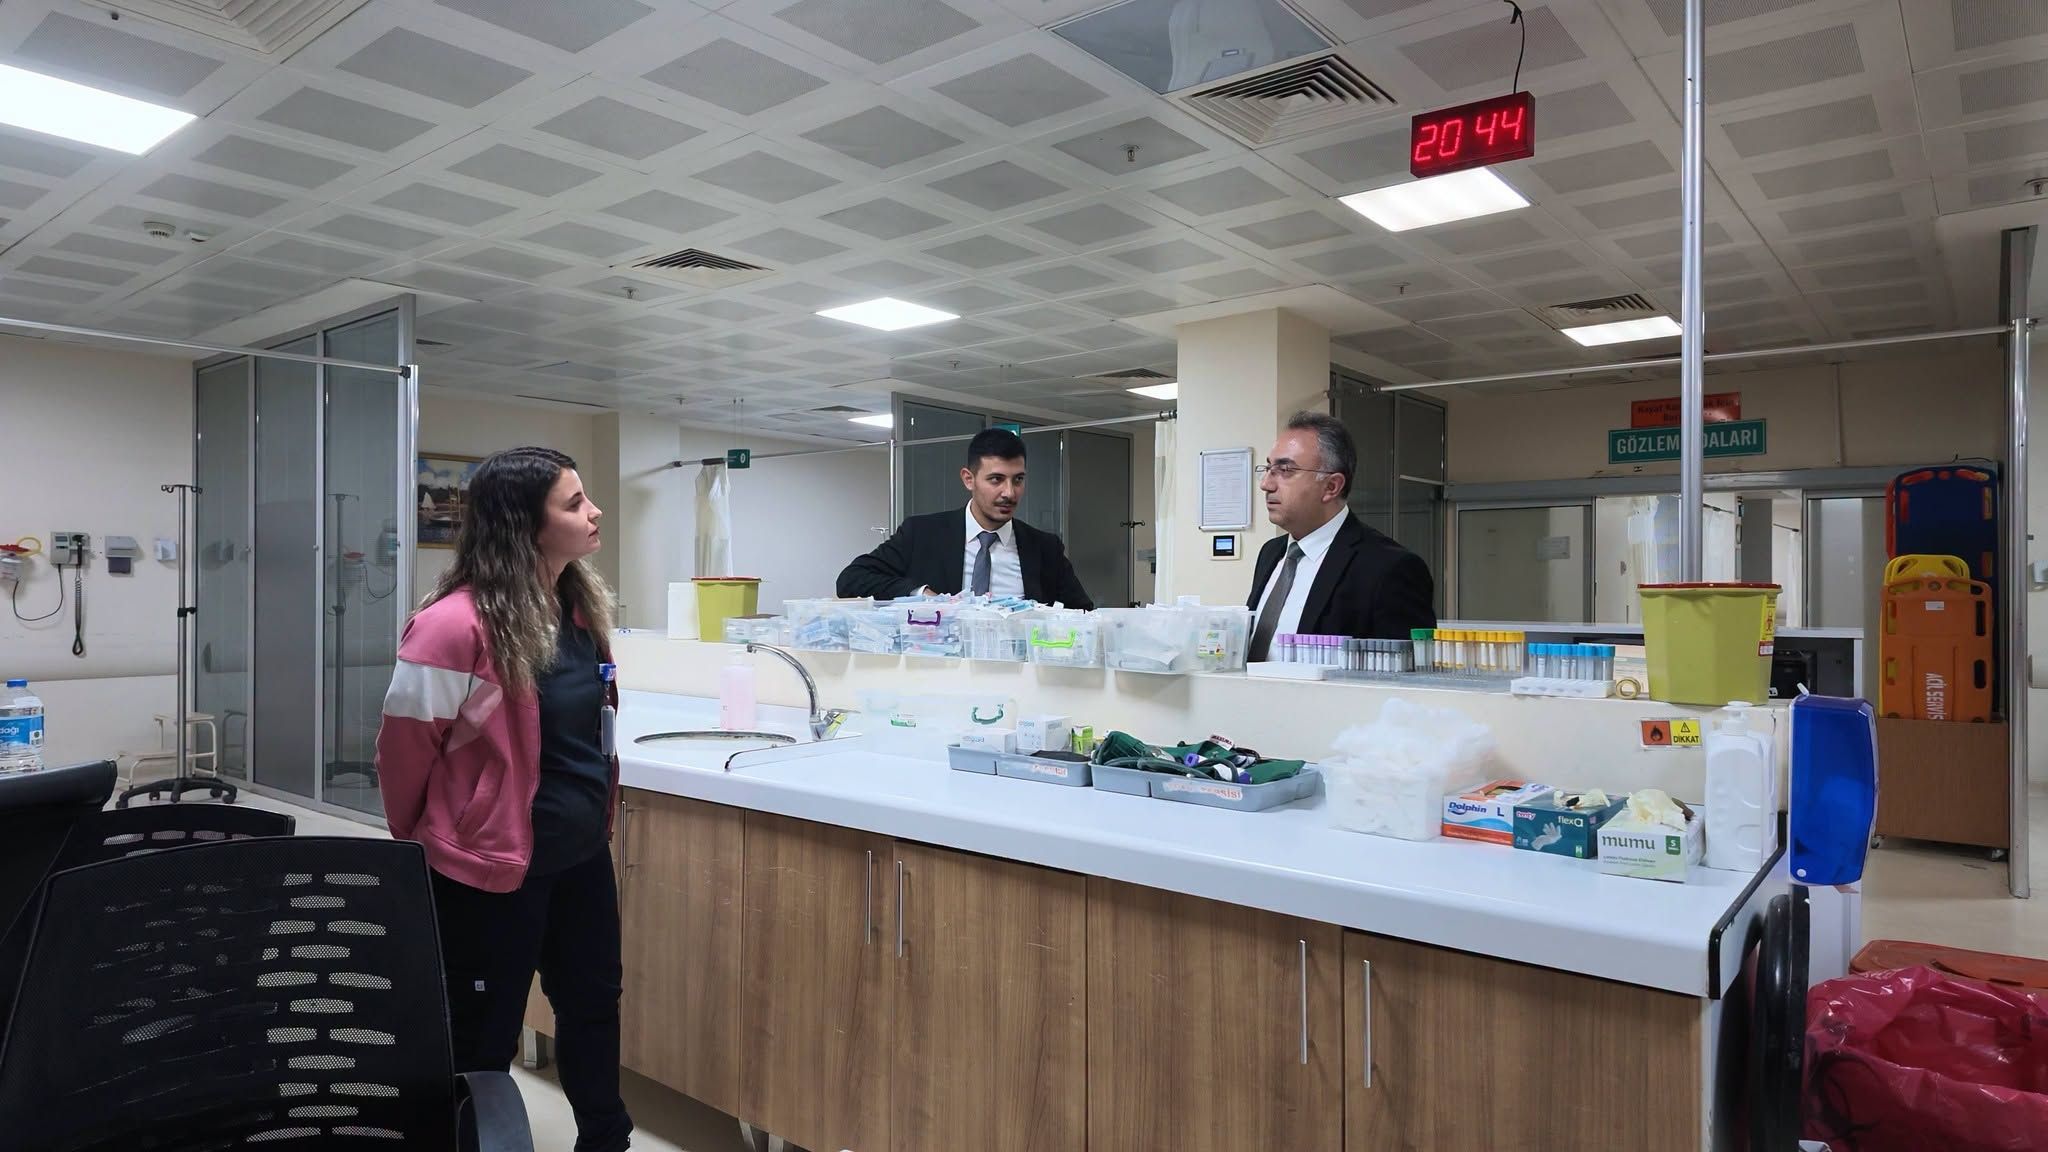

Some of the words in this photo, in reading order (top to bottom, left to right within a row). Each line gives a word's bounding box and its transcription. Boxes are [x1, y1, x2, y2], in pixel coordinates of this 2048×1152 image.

[1414, 118, 1463, 162] 20
[1475, 107, 1524, 146] 44
[1616, 435, 1680, 454] GÖZLEM
[1449, 801, 1487, 814] Dolphin
[1497, 806, 1505, 817] L
[1602, 835, 1656, 850] mumu
